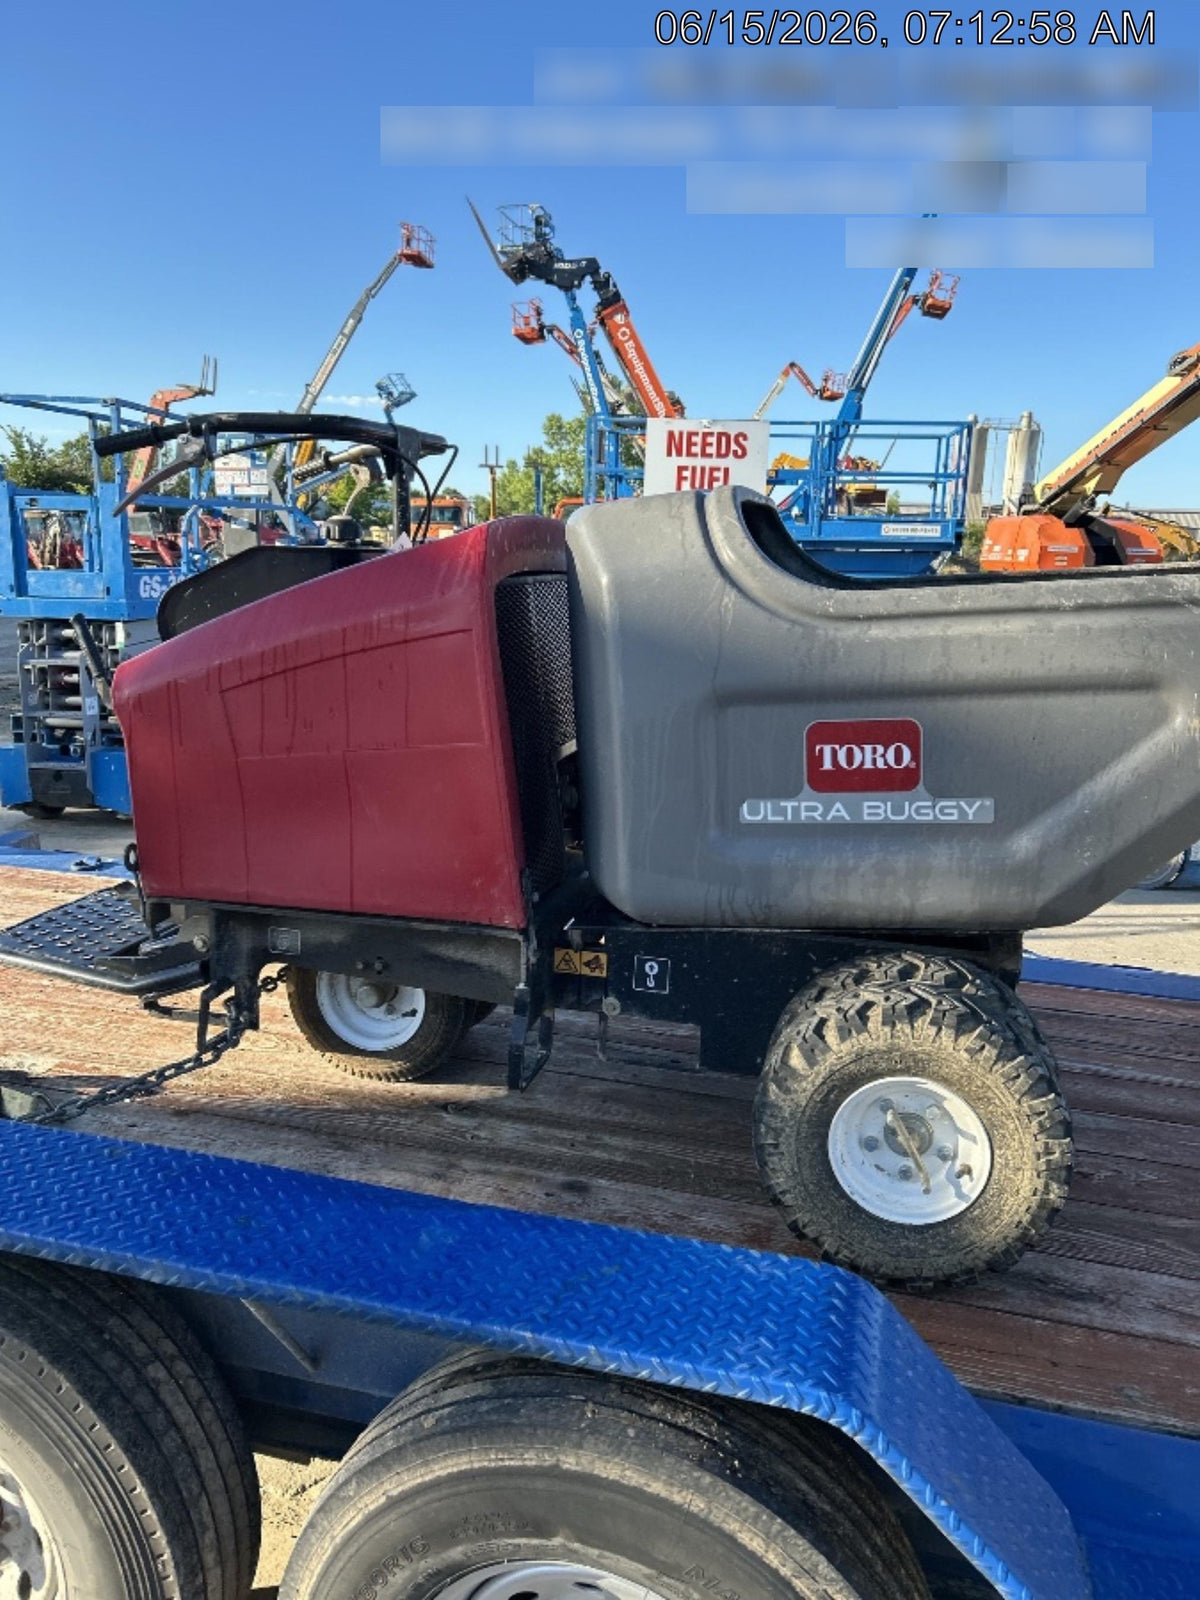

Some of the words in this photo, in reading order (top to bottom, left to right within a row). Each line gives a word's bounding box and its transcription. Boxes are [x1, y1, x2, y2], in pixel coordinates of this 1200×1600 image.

[666, 430, 749, 459] NEEDS
[815, 742, 912, 770] TORO
[741, 801, 850, 821] ULTRA
